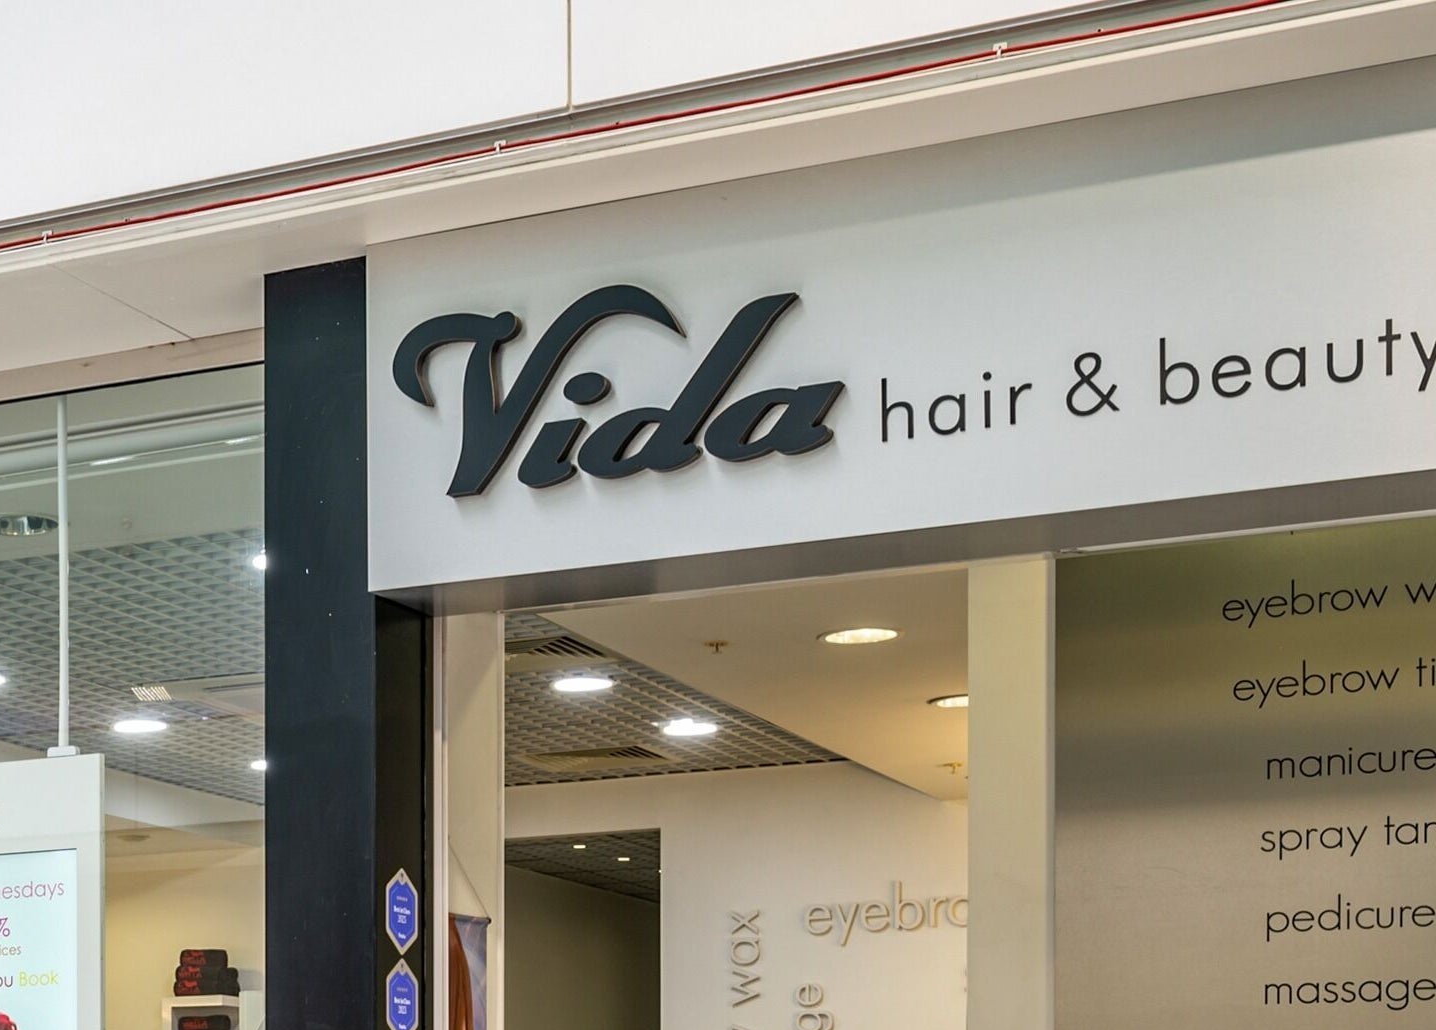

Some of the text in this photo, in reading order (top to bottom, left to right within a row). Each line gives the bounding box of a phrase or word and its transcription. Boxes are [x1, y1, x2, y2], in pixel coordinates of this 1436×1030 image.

[392, 284, 1436, 498] Vida hair & beauty
[1222, 579, 1389, 628] eyebrow
[1232, 659, 1400, 709] eyebrow
[1266, 745, 1436, 780] manicure
[1260, 824, 1368, 860] spray
[1266, 894, 1436, 941] pedicure
[18, 970, 60, 987] Book
[729, 909, 762, 1009] wax
[1264, 977, 1436, 1011] massage
